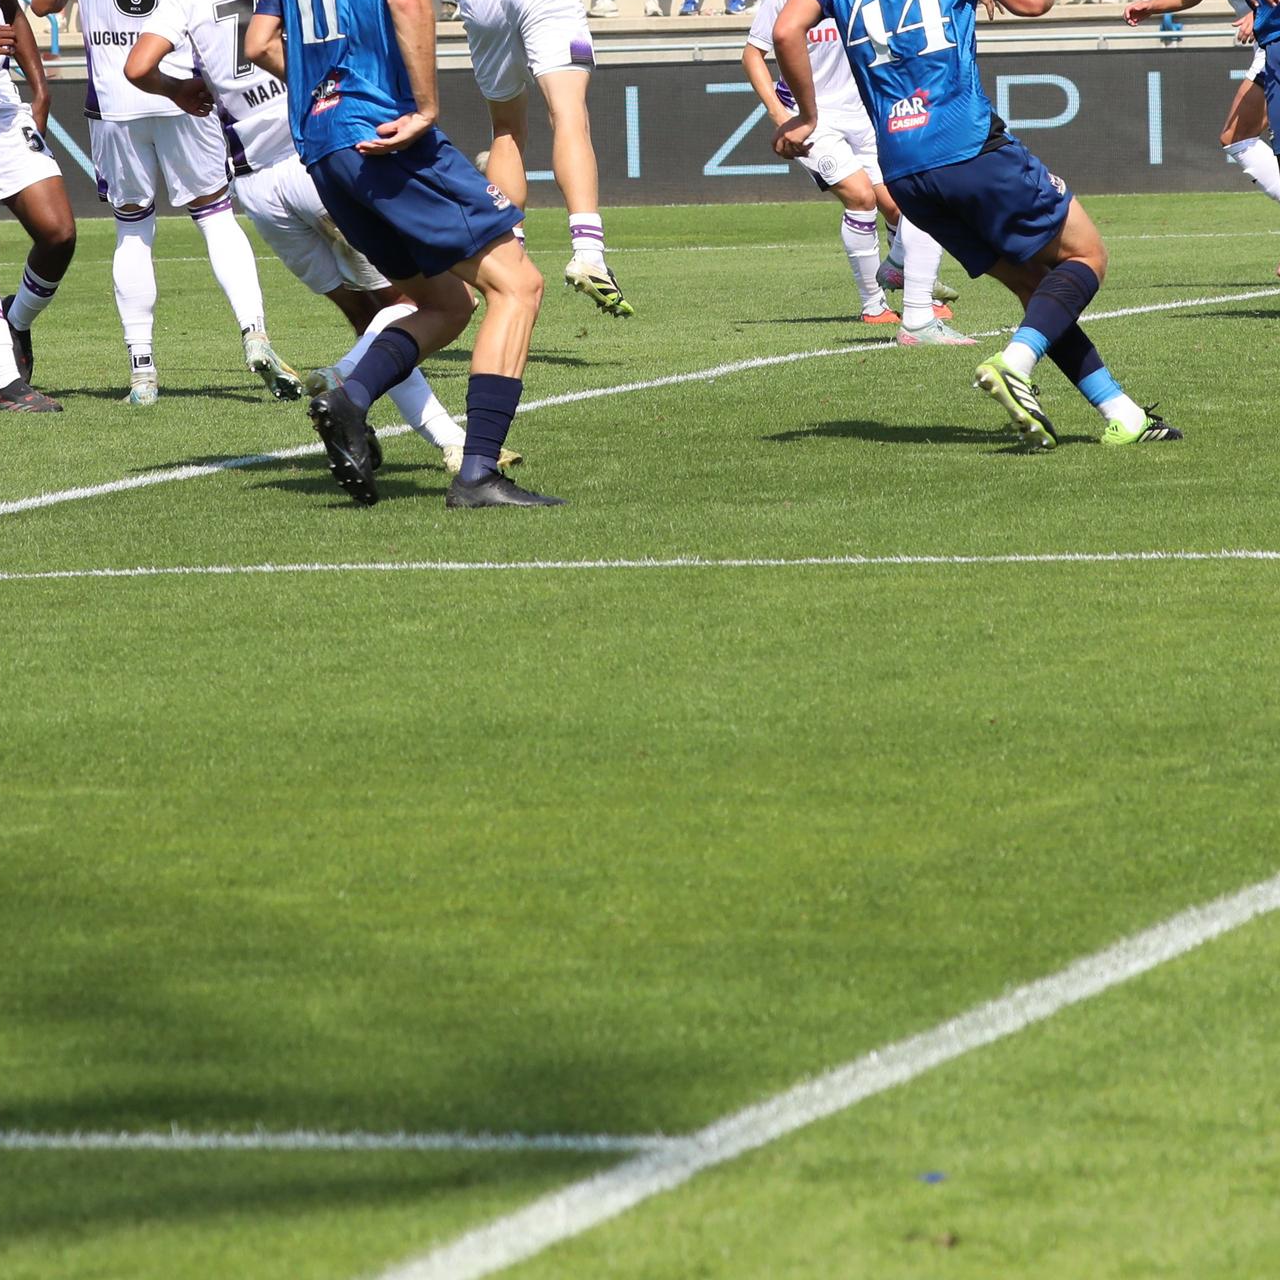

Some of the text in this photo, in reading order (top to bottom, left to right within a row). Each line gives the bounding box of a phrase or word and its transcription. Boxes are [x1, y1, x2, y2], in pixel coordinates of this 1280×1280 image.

[888, 96, 927, 119] STAR
[891, 116, 926, 131] CASINO
[21, 125, 45, 154] 5
